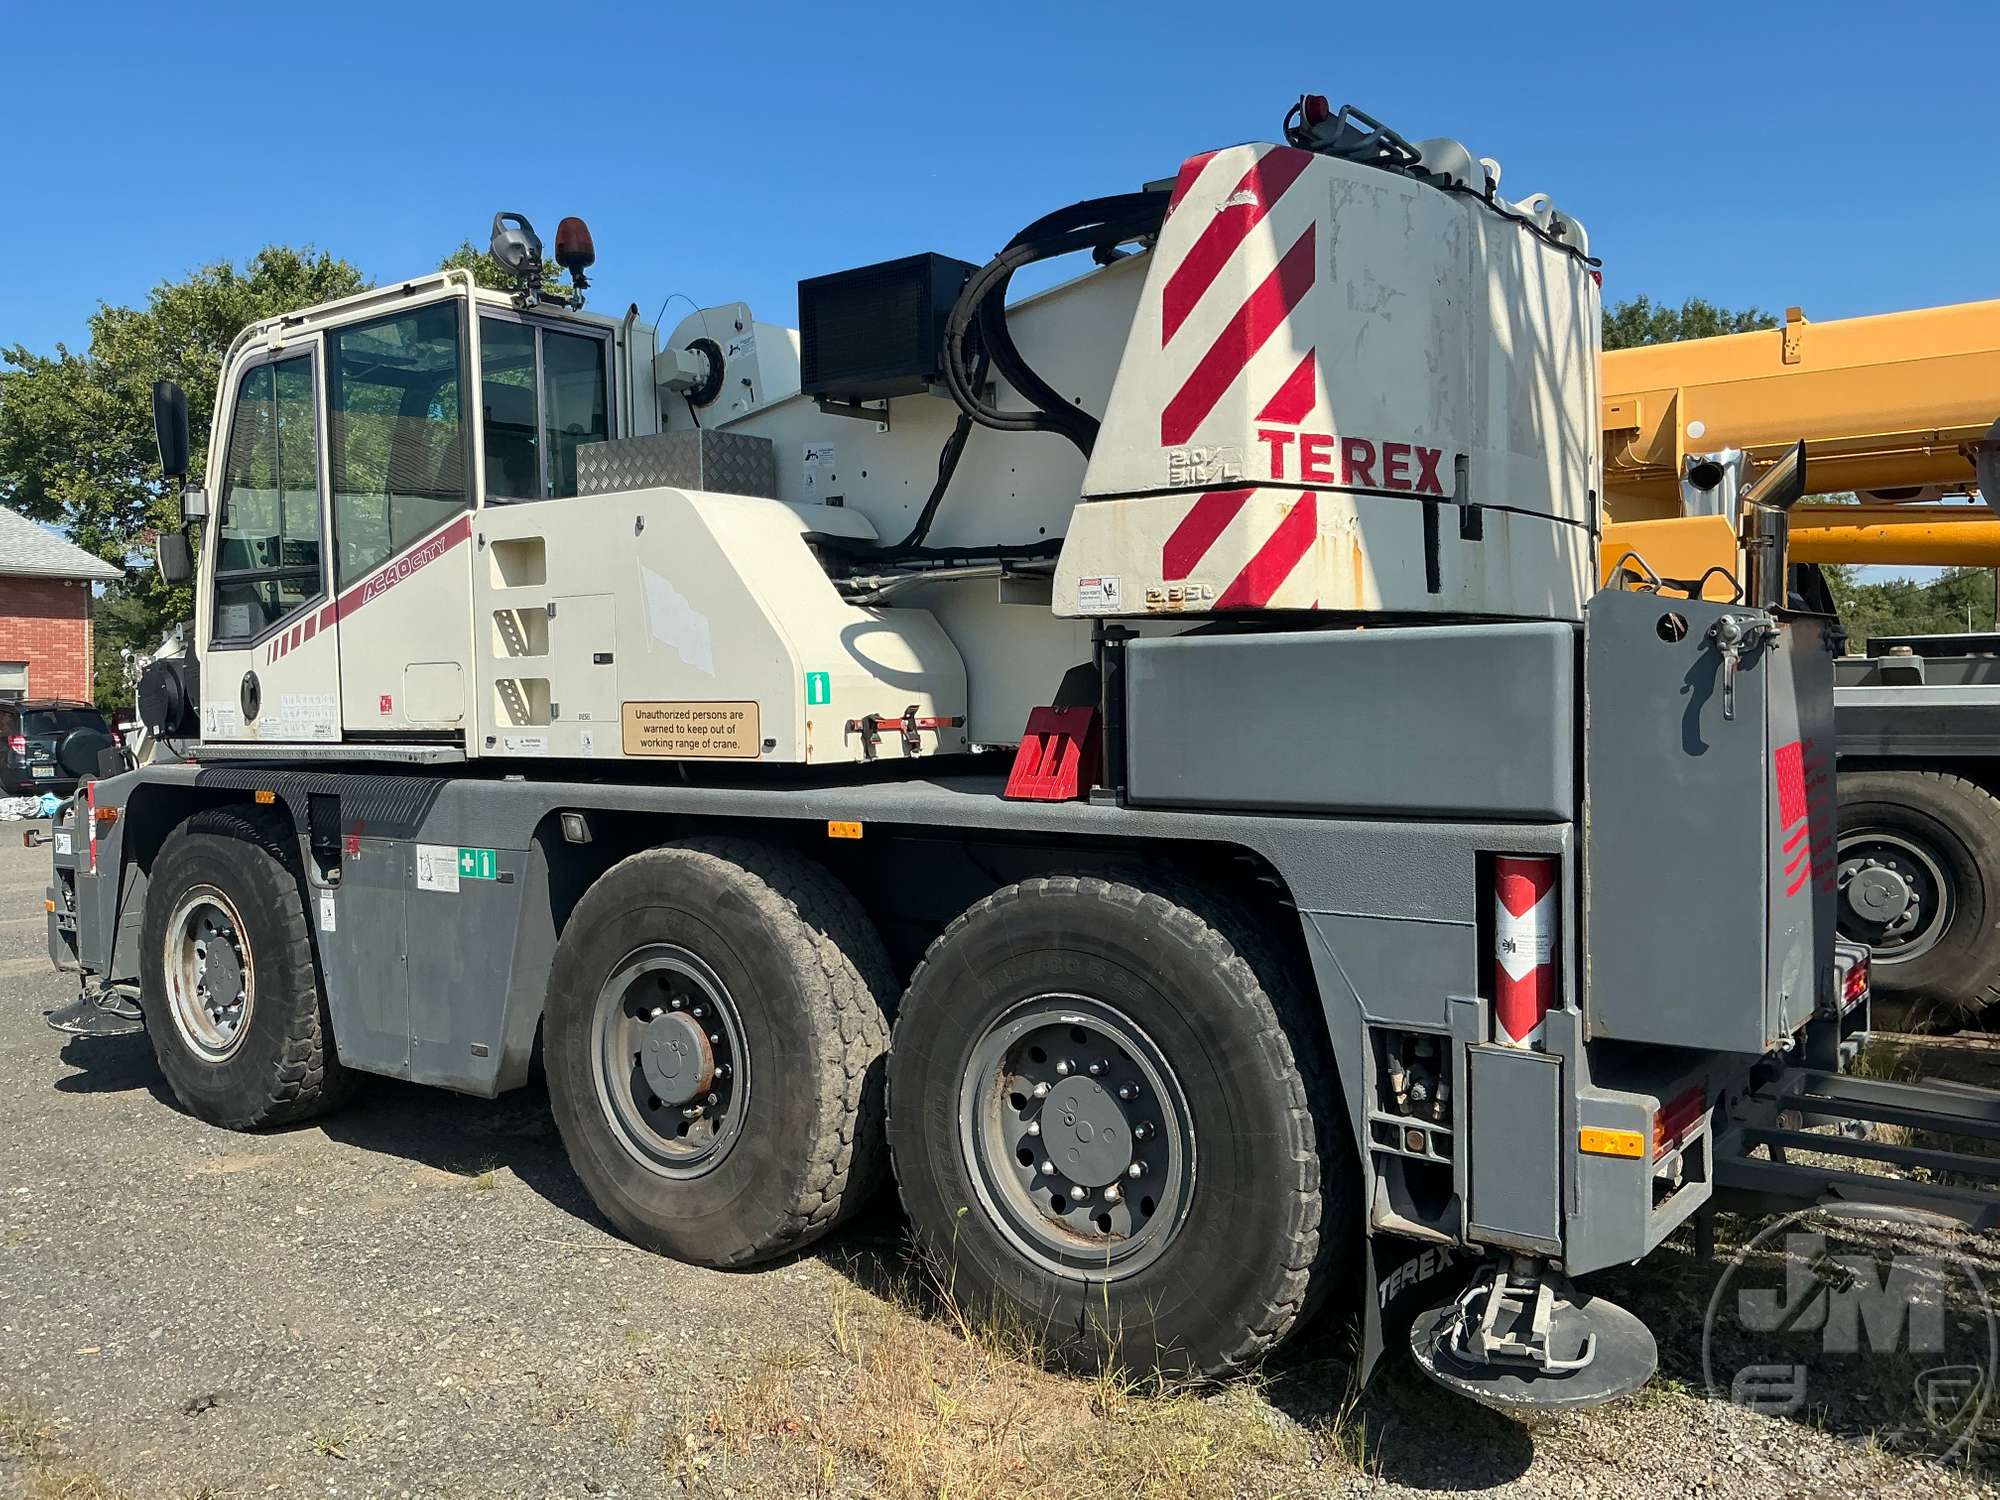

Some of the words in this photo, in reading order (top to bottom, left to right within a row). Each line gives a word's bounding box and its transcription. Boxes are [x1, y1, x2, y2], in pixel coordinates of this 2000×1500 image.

[1257, 428, 1445, 496] TEREX
[635, 709, 690, 720] Unauthorized
[692, 711, 727, 721] persons
[729, 711, 744, 720] are
[643, 724, 674, 734] warned
[676, 725, 685, 734] to
[687, 724, 708, 735] keep
[710, 725, 724, 734] out
[726, 724, 736, 734] of
[640, 738, 673, 750] working
[675, 740, 699, 750] range
[702, 738, 711, 748] of
[713, 740, 740, 749] crane.
[1379, 1246, 1454, 1309] TEREX
